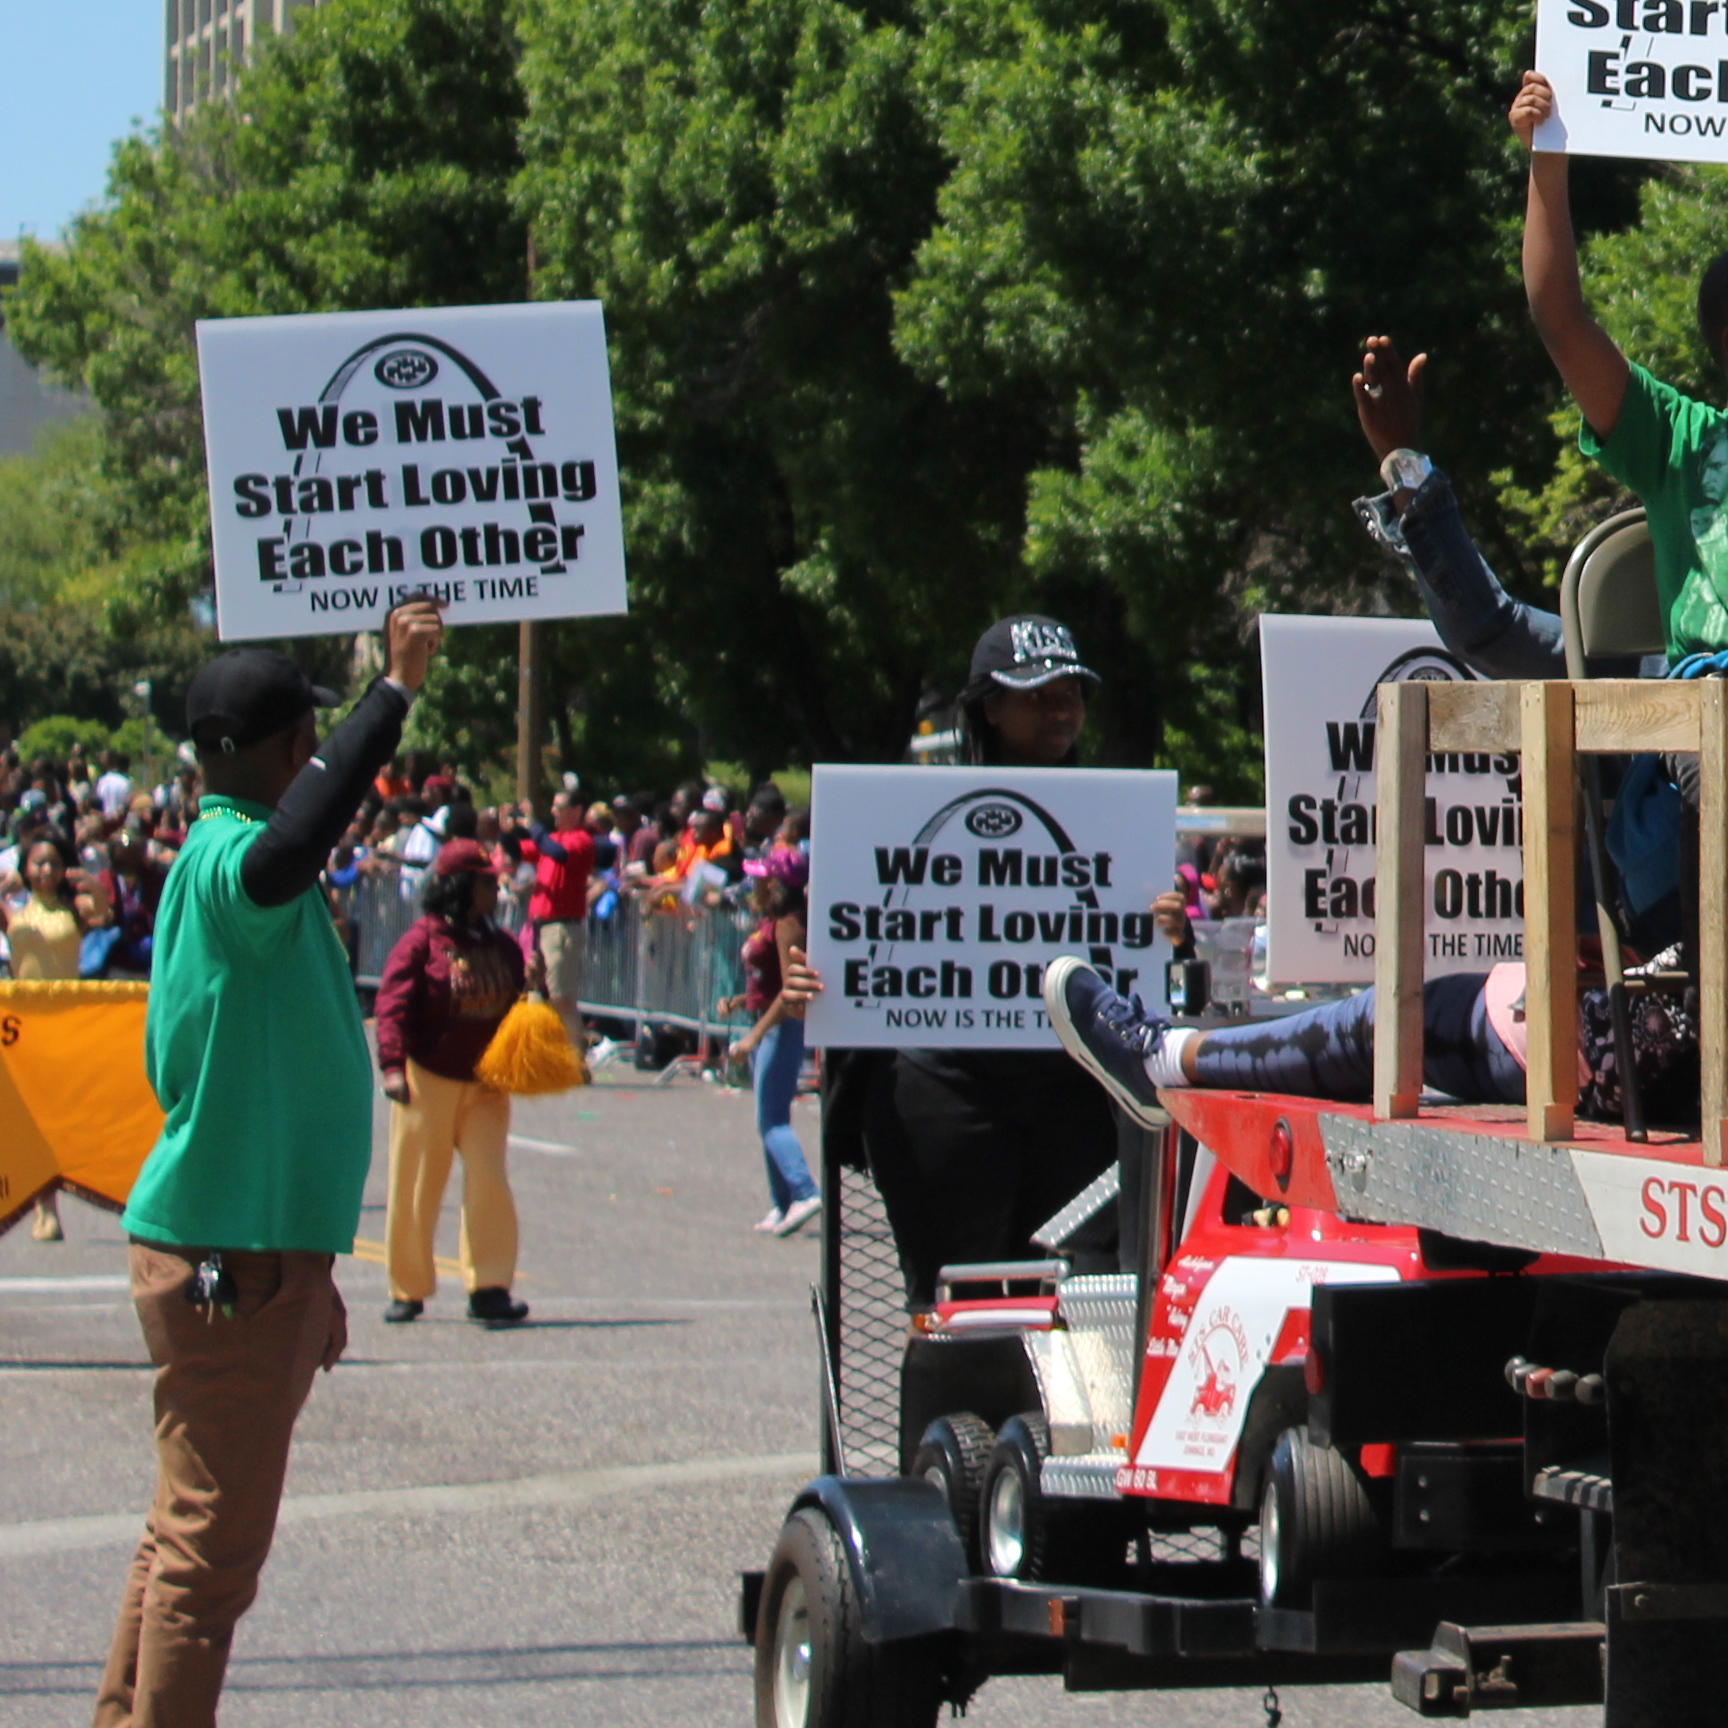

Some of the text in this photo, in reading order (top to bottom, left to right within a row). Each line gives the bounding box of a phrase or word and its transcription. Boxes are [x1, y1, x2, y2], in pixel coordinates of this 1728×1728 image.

[1643, 113, 1727, 138] NOW
[276, 395, 546, 451] We Must
[233, 458, 597, 519] Start Loving
[256, 523, 584, 581] Each Other
[310, 587, 378, 612] NOW
[415, 579, 466, 604] THE
[474, 576, 539, 600] TIME
[1327, 722, 1376, 773] W
[1288, 794, 1522, 847] Sta Lovi
[874, 846, 1112, 887] We Must
[1304, 868, 1523, 920] Eac Oth
[829, 901, 1154, 948] Start Loving
[1344, 933, 1523, 958] NO THE TIME
[844, 958, 1138, 999] Each Otr
[886, 1009, 947, 1028] NOW
[955, 1009, 974, 1028] IS
[981, 1009, 1025, 1029] THE
[1639, 1176, 1728, 1248] STS
